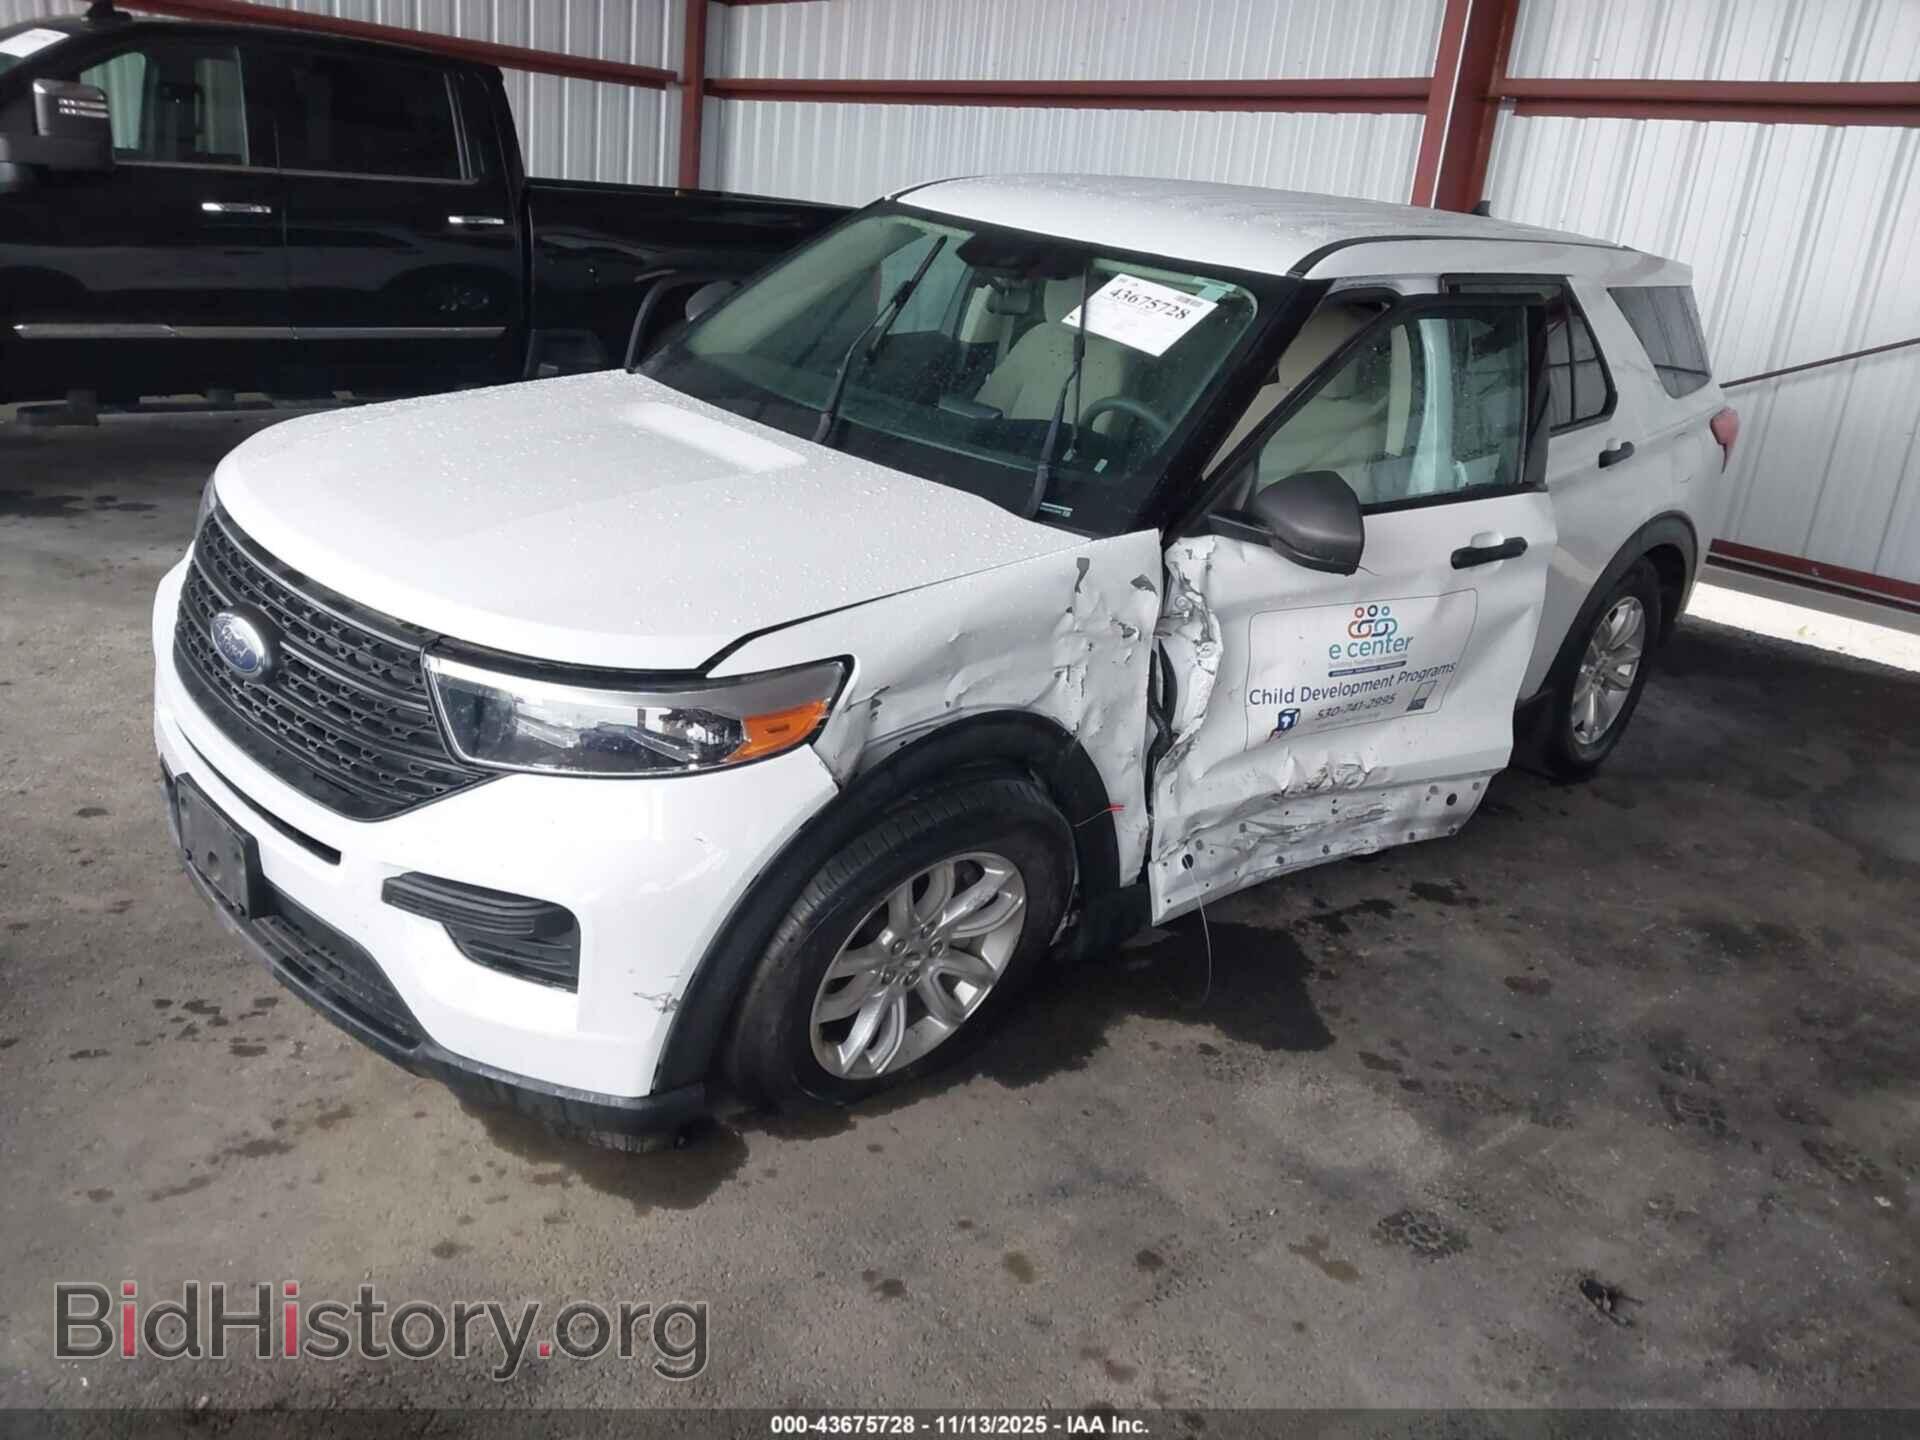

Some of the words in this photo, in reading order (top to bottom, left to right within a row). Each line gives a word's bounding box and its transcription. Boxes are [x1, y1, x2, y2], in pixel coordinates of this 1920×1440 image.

[1109, 288, 1190, 320] 43675728
[1329, 643, 1342, 660] e
[1347, 636, 1414, 658] center
[1249, 687, 1295, 706] Child
[1300, 674, 1395, 702] Development
[1397, 661, 1457, 685] Programs
